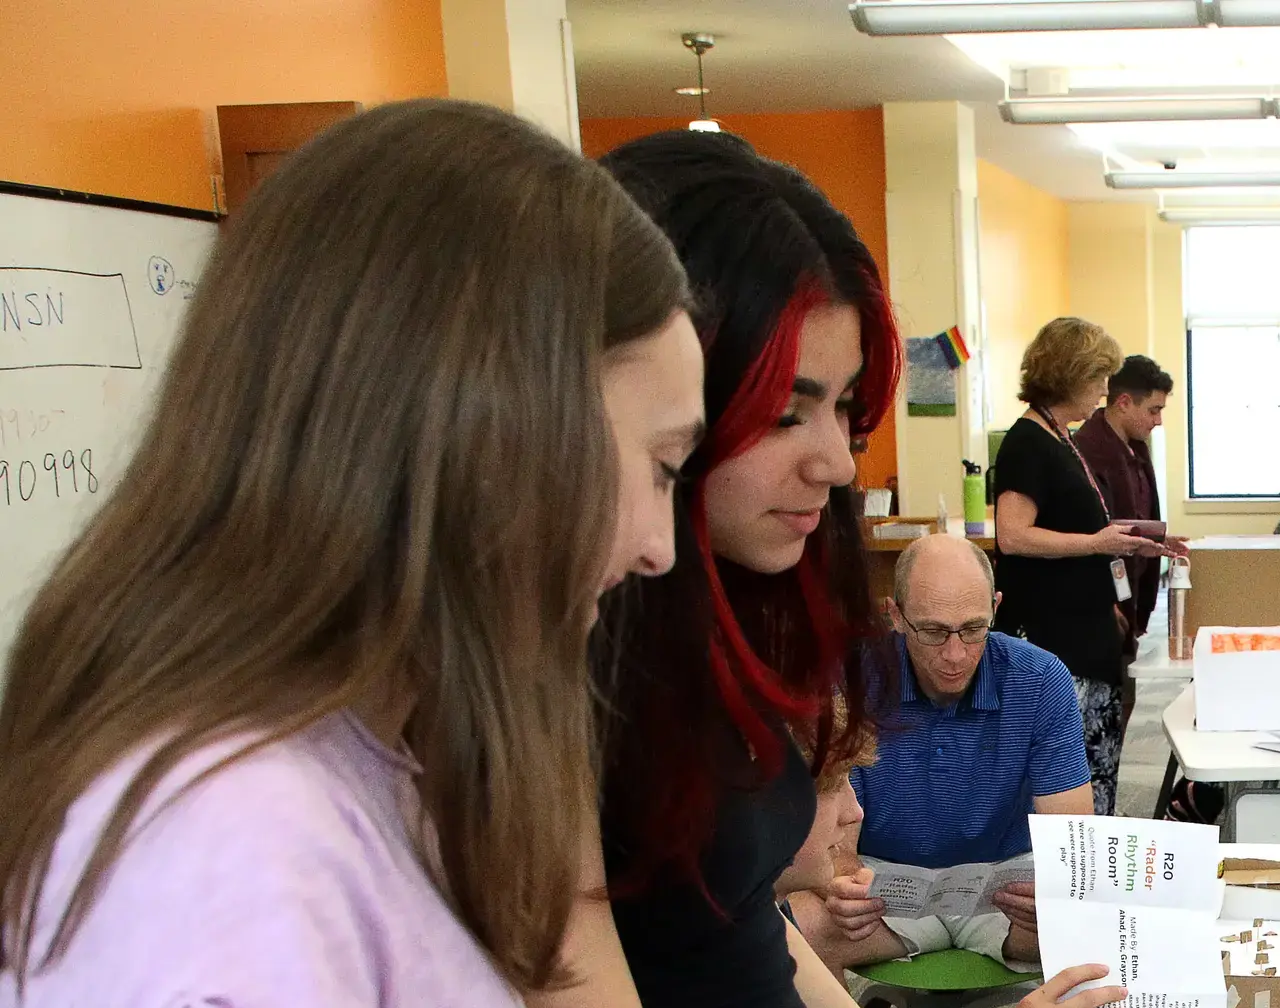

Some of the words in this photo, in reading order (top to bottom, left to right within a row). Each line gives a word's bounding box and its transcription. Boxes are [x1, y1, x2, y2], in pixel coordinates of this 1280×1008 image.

[1125, 835, 1138, 891] Rhythm
[1163, 853, 1174, 880] R20
[1070, 889, 1076, 897] to
[1079, 892, 1085, 900] to
[1119, 954, 1128, 988] Grayson
